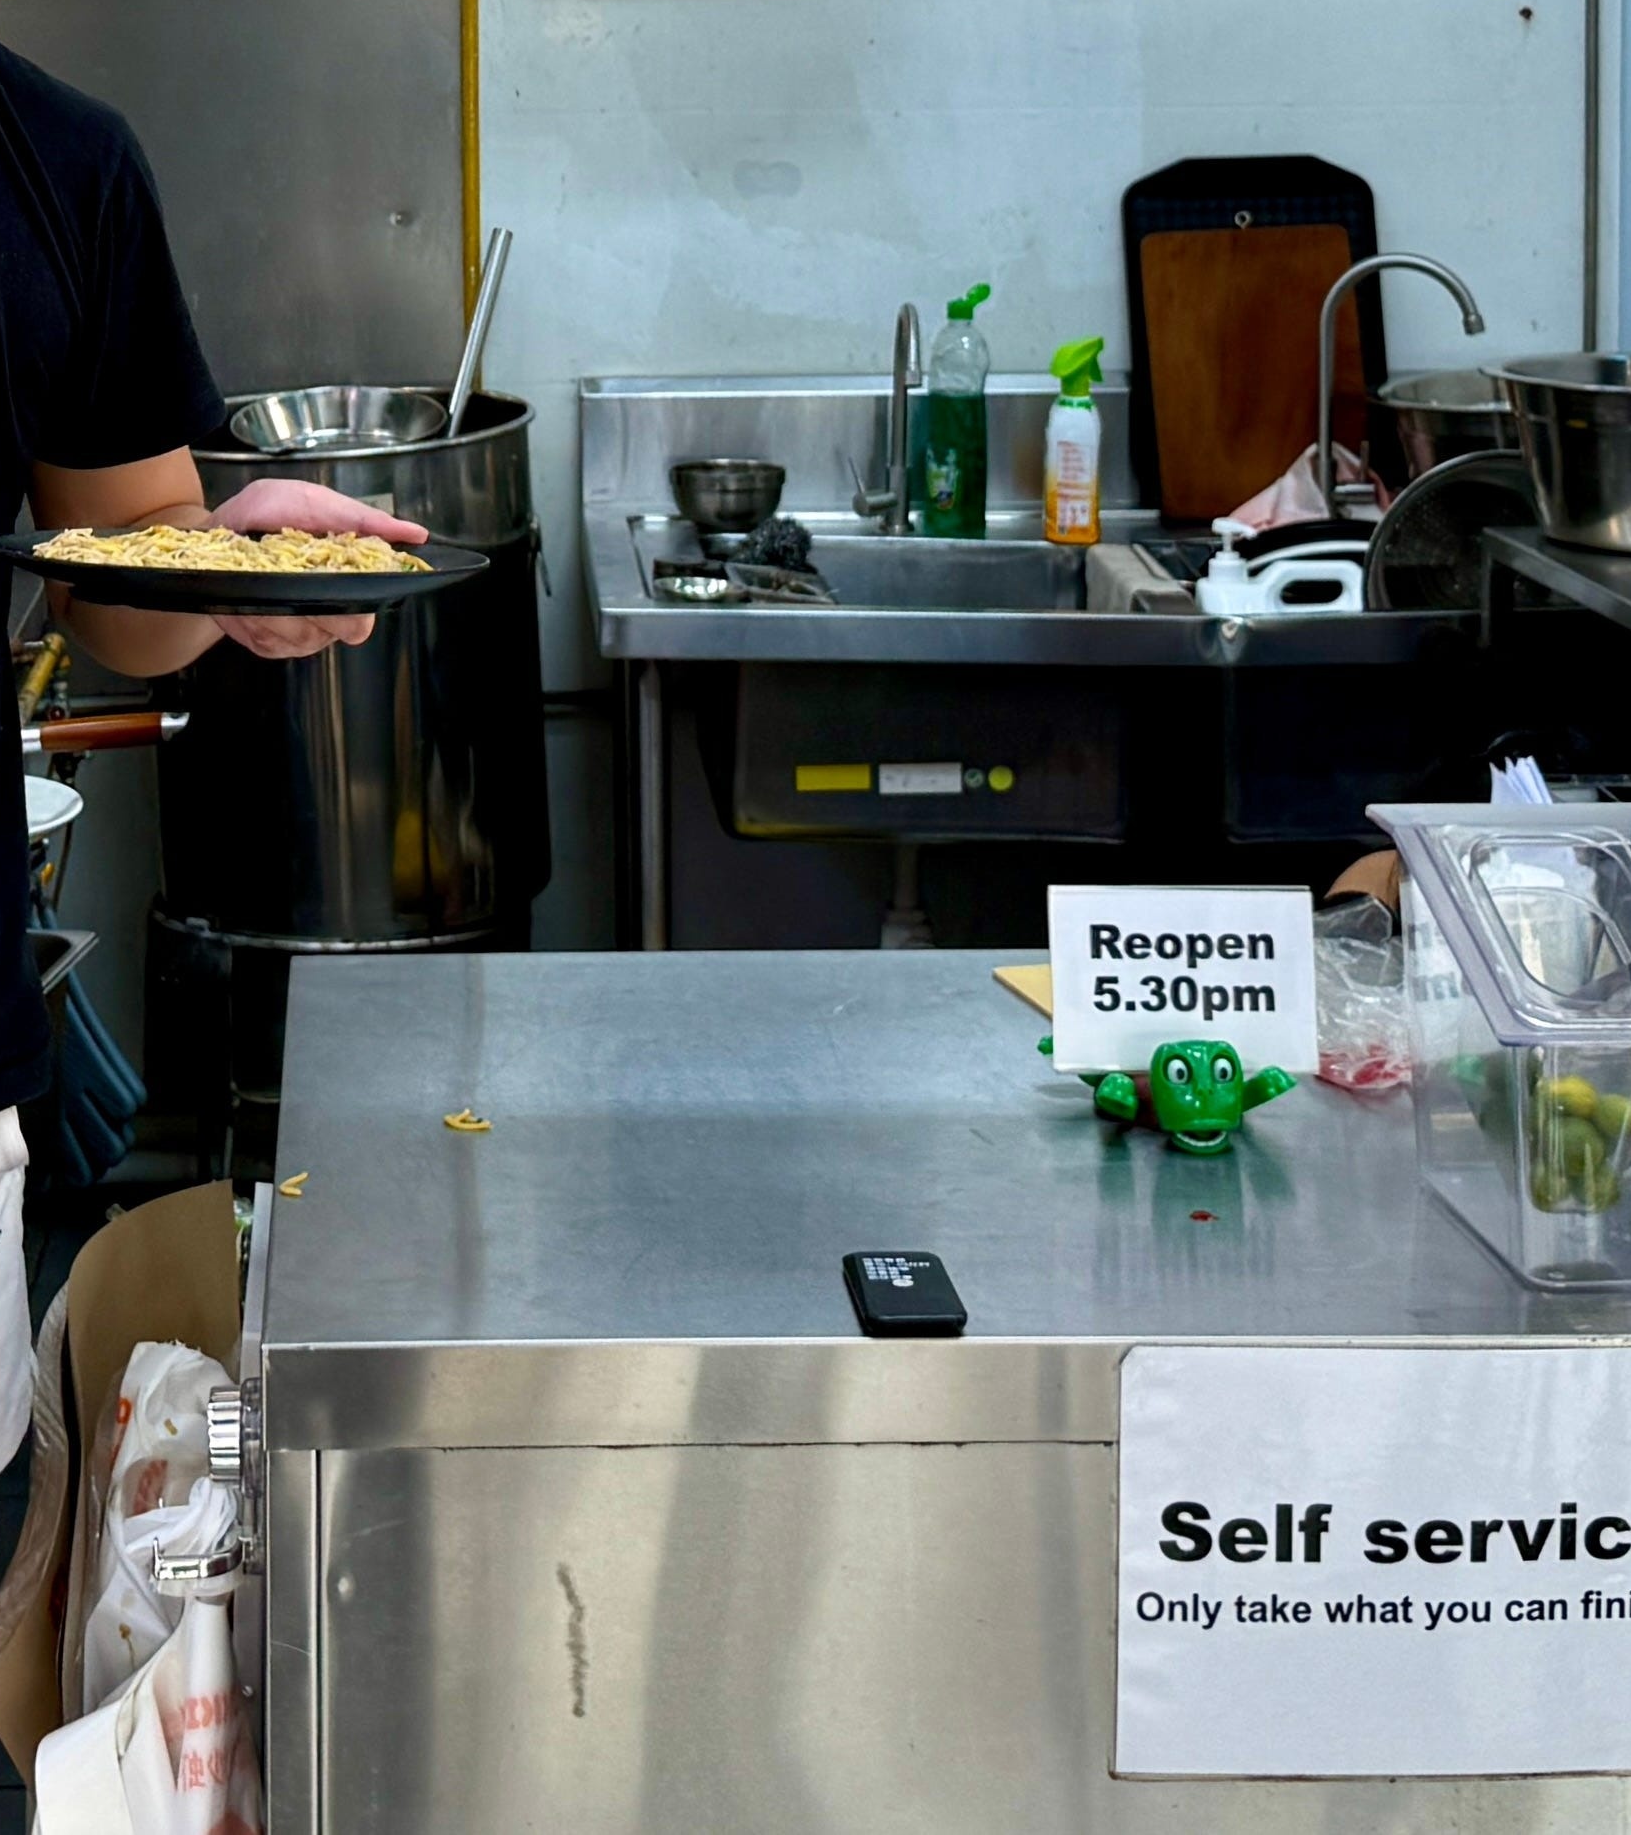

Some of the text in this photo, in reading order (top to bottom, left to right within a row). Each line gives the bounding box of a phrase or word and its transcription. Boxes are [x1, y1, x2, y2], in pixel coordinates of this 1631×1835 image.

[1089, 923, 1275, 969] Reopen
[1093, 975, 1276, 1021] 5.30pm
[1158, 1501, 1333, 1563] Self
[1136, 1592, 1222, 1630] Only
[1235, 1593, 1311, 1624] take
[1324, 1594, 1413, 1623] what
[1425, 1602, 1491, 1630] you
[1505, 1597, 1568, 1622] can
